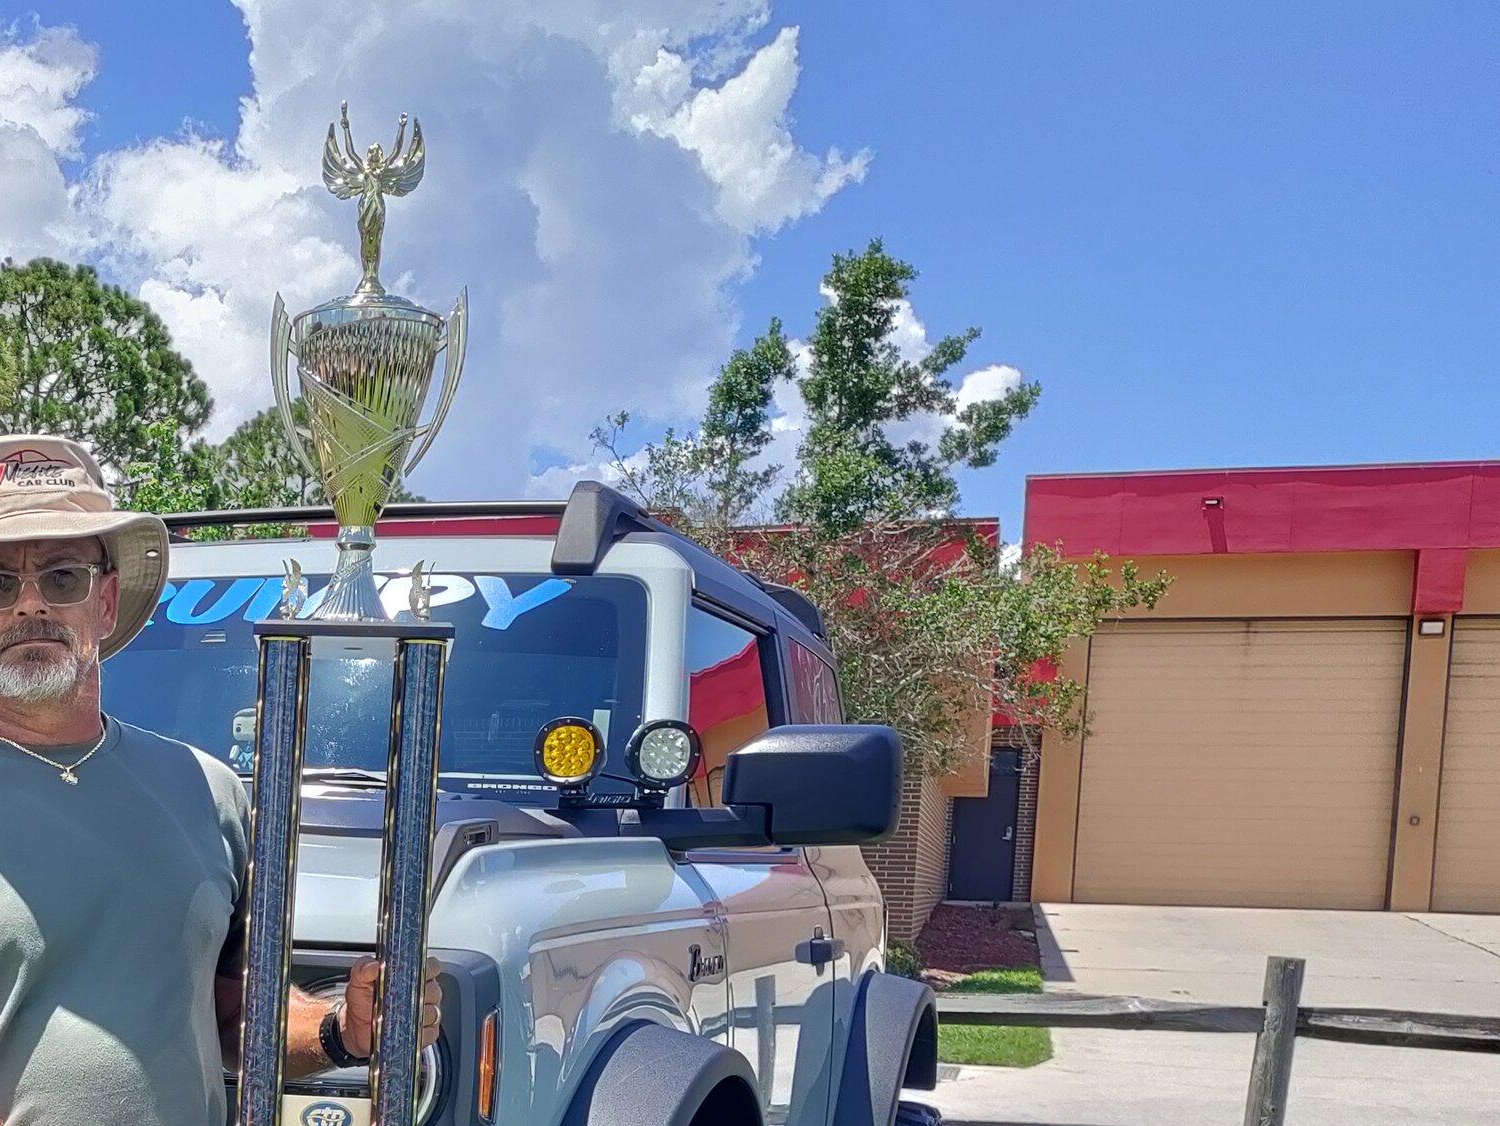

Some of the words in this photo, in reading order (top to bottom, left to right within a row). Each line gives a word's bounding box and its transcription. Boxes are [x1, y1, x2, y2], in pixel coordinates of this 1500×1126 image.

[17, 479, 42, 487] CAR
[46, 479, 76, 488] CLUB
[142, 577, 573, 631] UMPY
